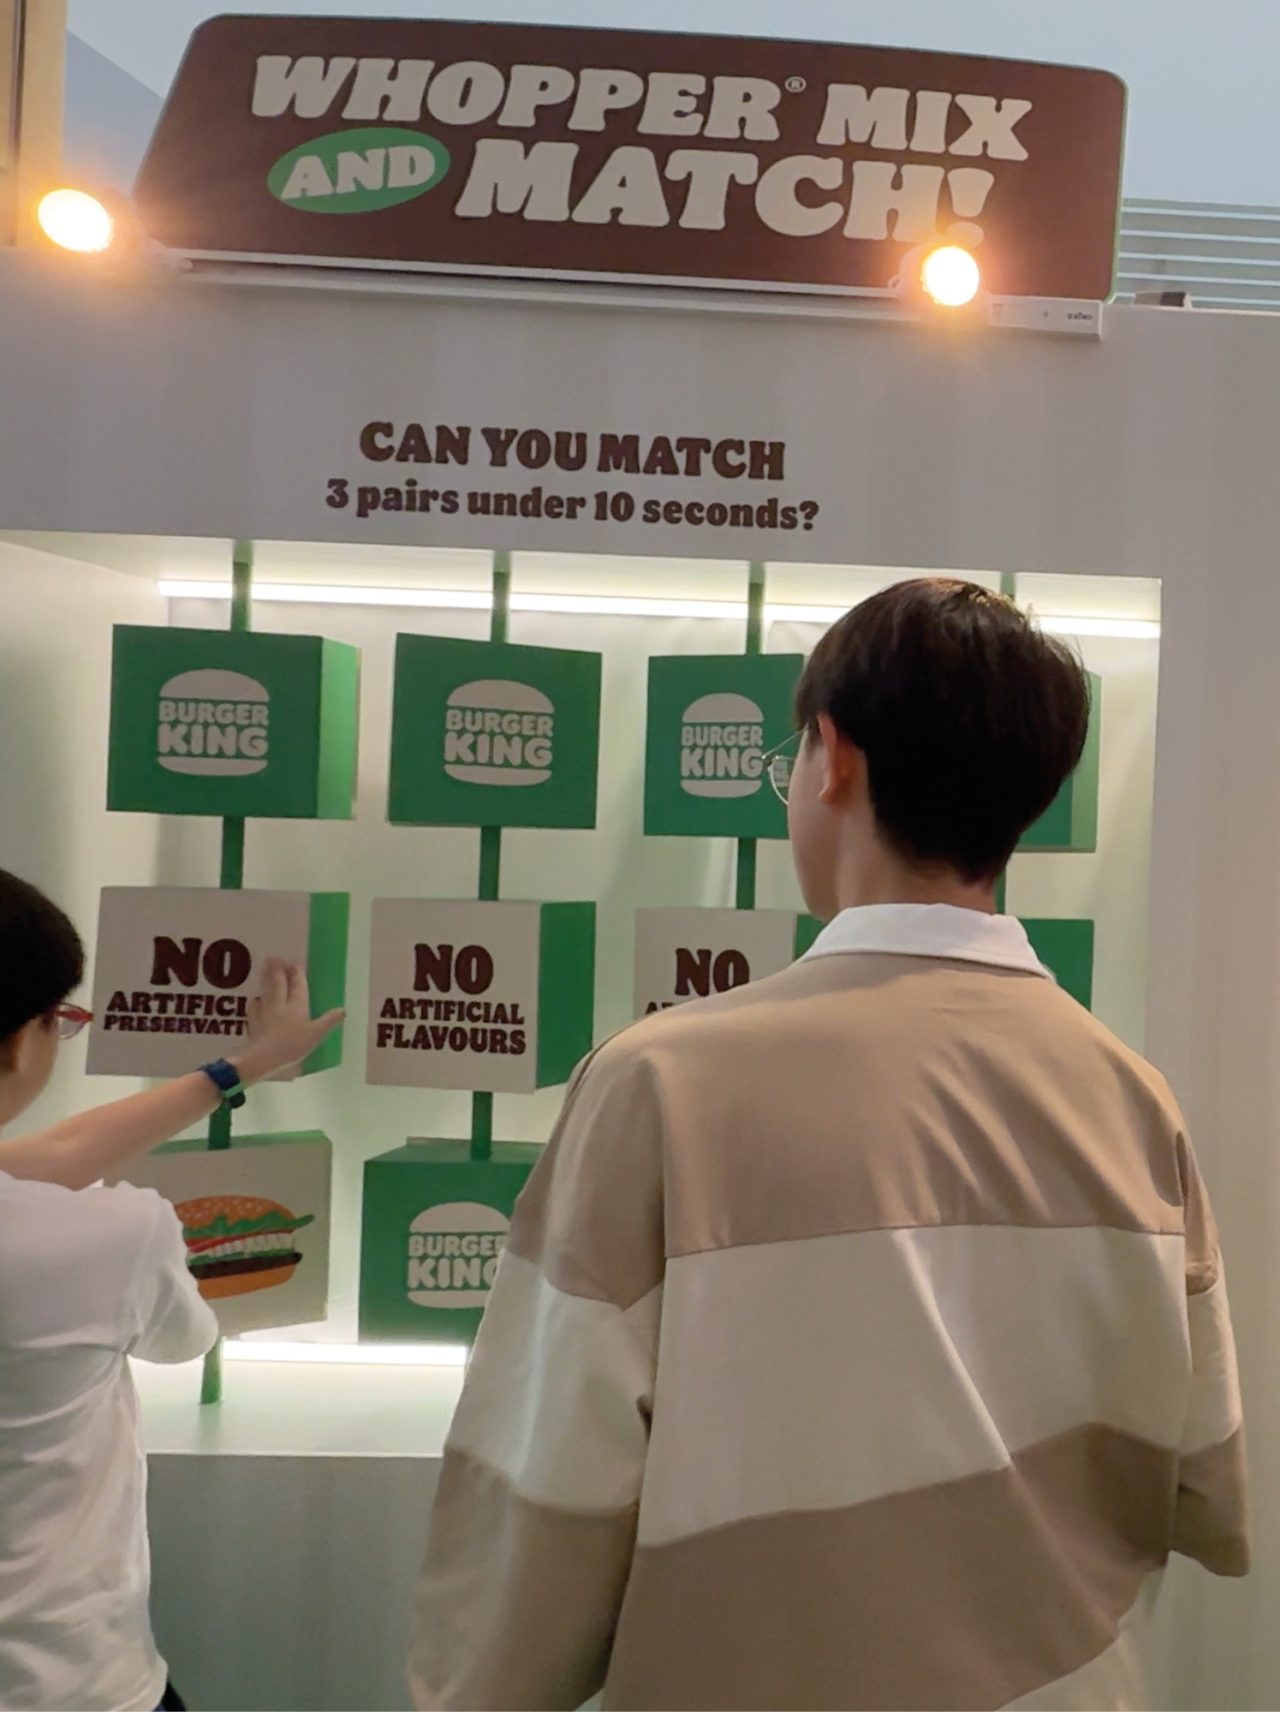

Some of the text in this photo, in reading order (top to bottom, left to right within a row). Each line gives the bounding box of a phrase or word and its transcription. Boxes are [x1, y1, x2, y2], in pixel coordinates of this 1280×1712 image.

[816, 83, 1032, 161] MIX
[280, 138, 994, 248] AND MATCH!
[360, 422, 785, 480] CAN YOU MATCH
[326, 479, 819, 531] 3 pairs under 10 seconds?
[158, 702, 270, 727] BURGER
[445, 709, 554, 738] BURGER
[157, 724, 269, 757] KING
[444, 731, 553, 768] KING
[681, 724, 763, 747] BURGER
[681, 747, 763, 779] KING
[150, 936, 252, 989] NO
[413, 943, 494, 995] NO
[674, 948, 750, 997] NO
[106, 990, 249, 1017] ARTIFICI
[380, 998, 525, 1026] ARTIFICIAL
[103, 1014, 249, 1036] PRESERVATI
[376, 1023, 526, 1056] FLAVOURS
